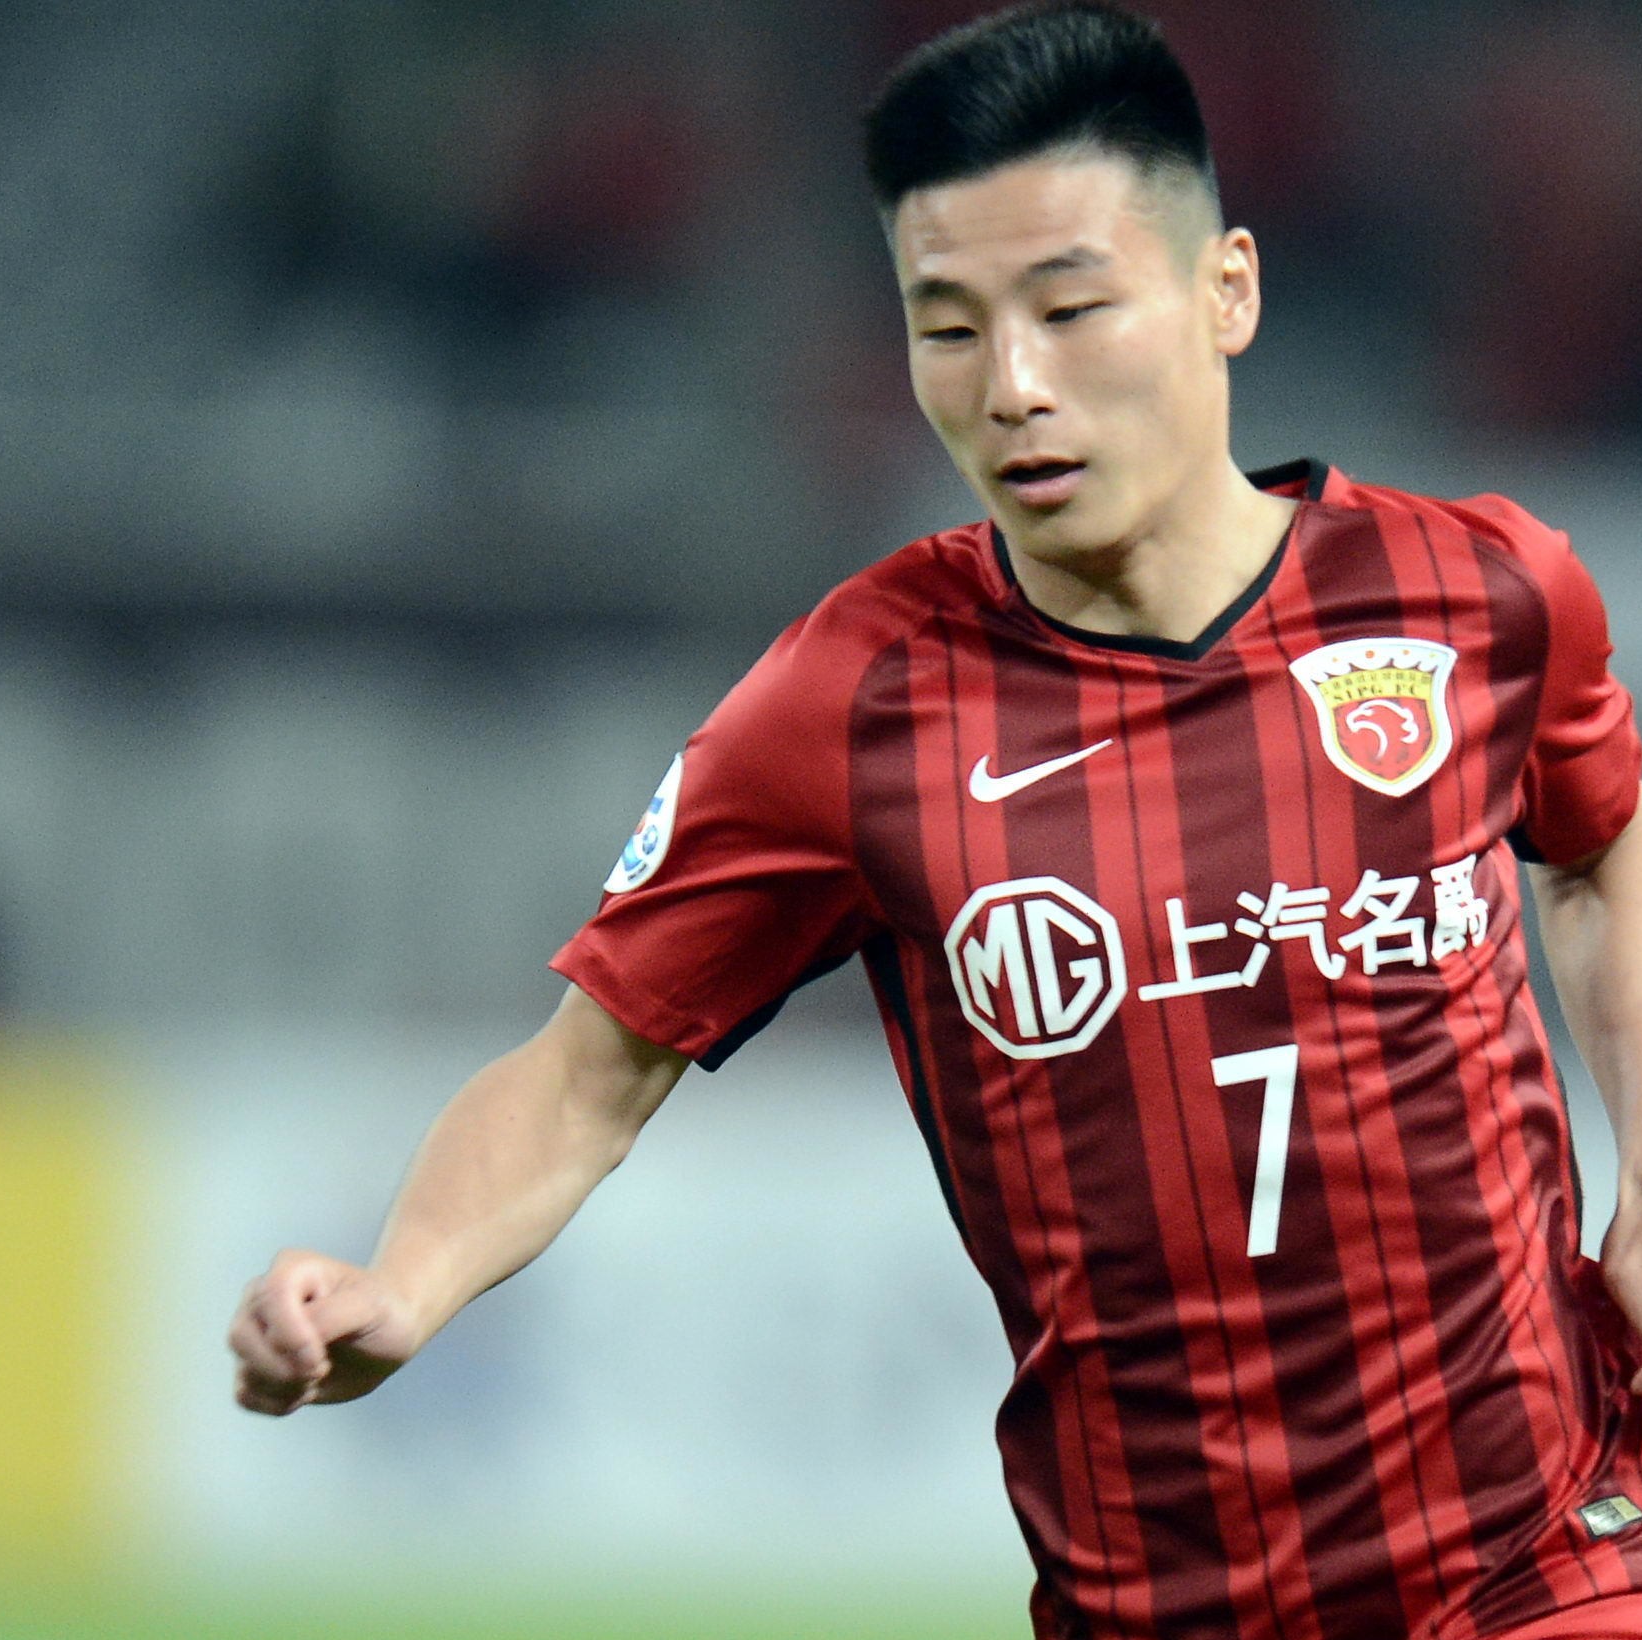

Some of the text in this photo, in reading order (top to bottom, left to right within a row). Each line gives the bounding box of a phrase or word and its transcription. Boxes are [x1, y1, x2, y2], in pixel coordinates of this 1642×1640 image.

[959, 896, 1107, 1040] MG
[1137, 853, 1490, 1002] 上汽名爵
[1210, 1043, 1299, 1258] 7
